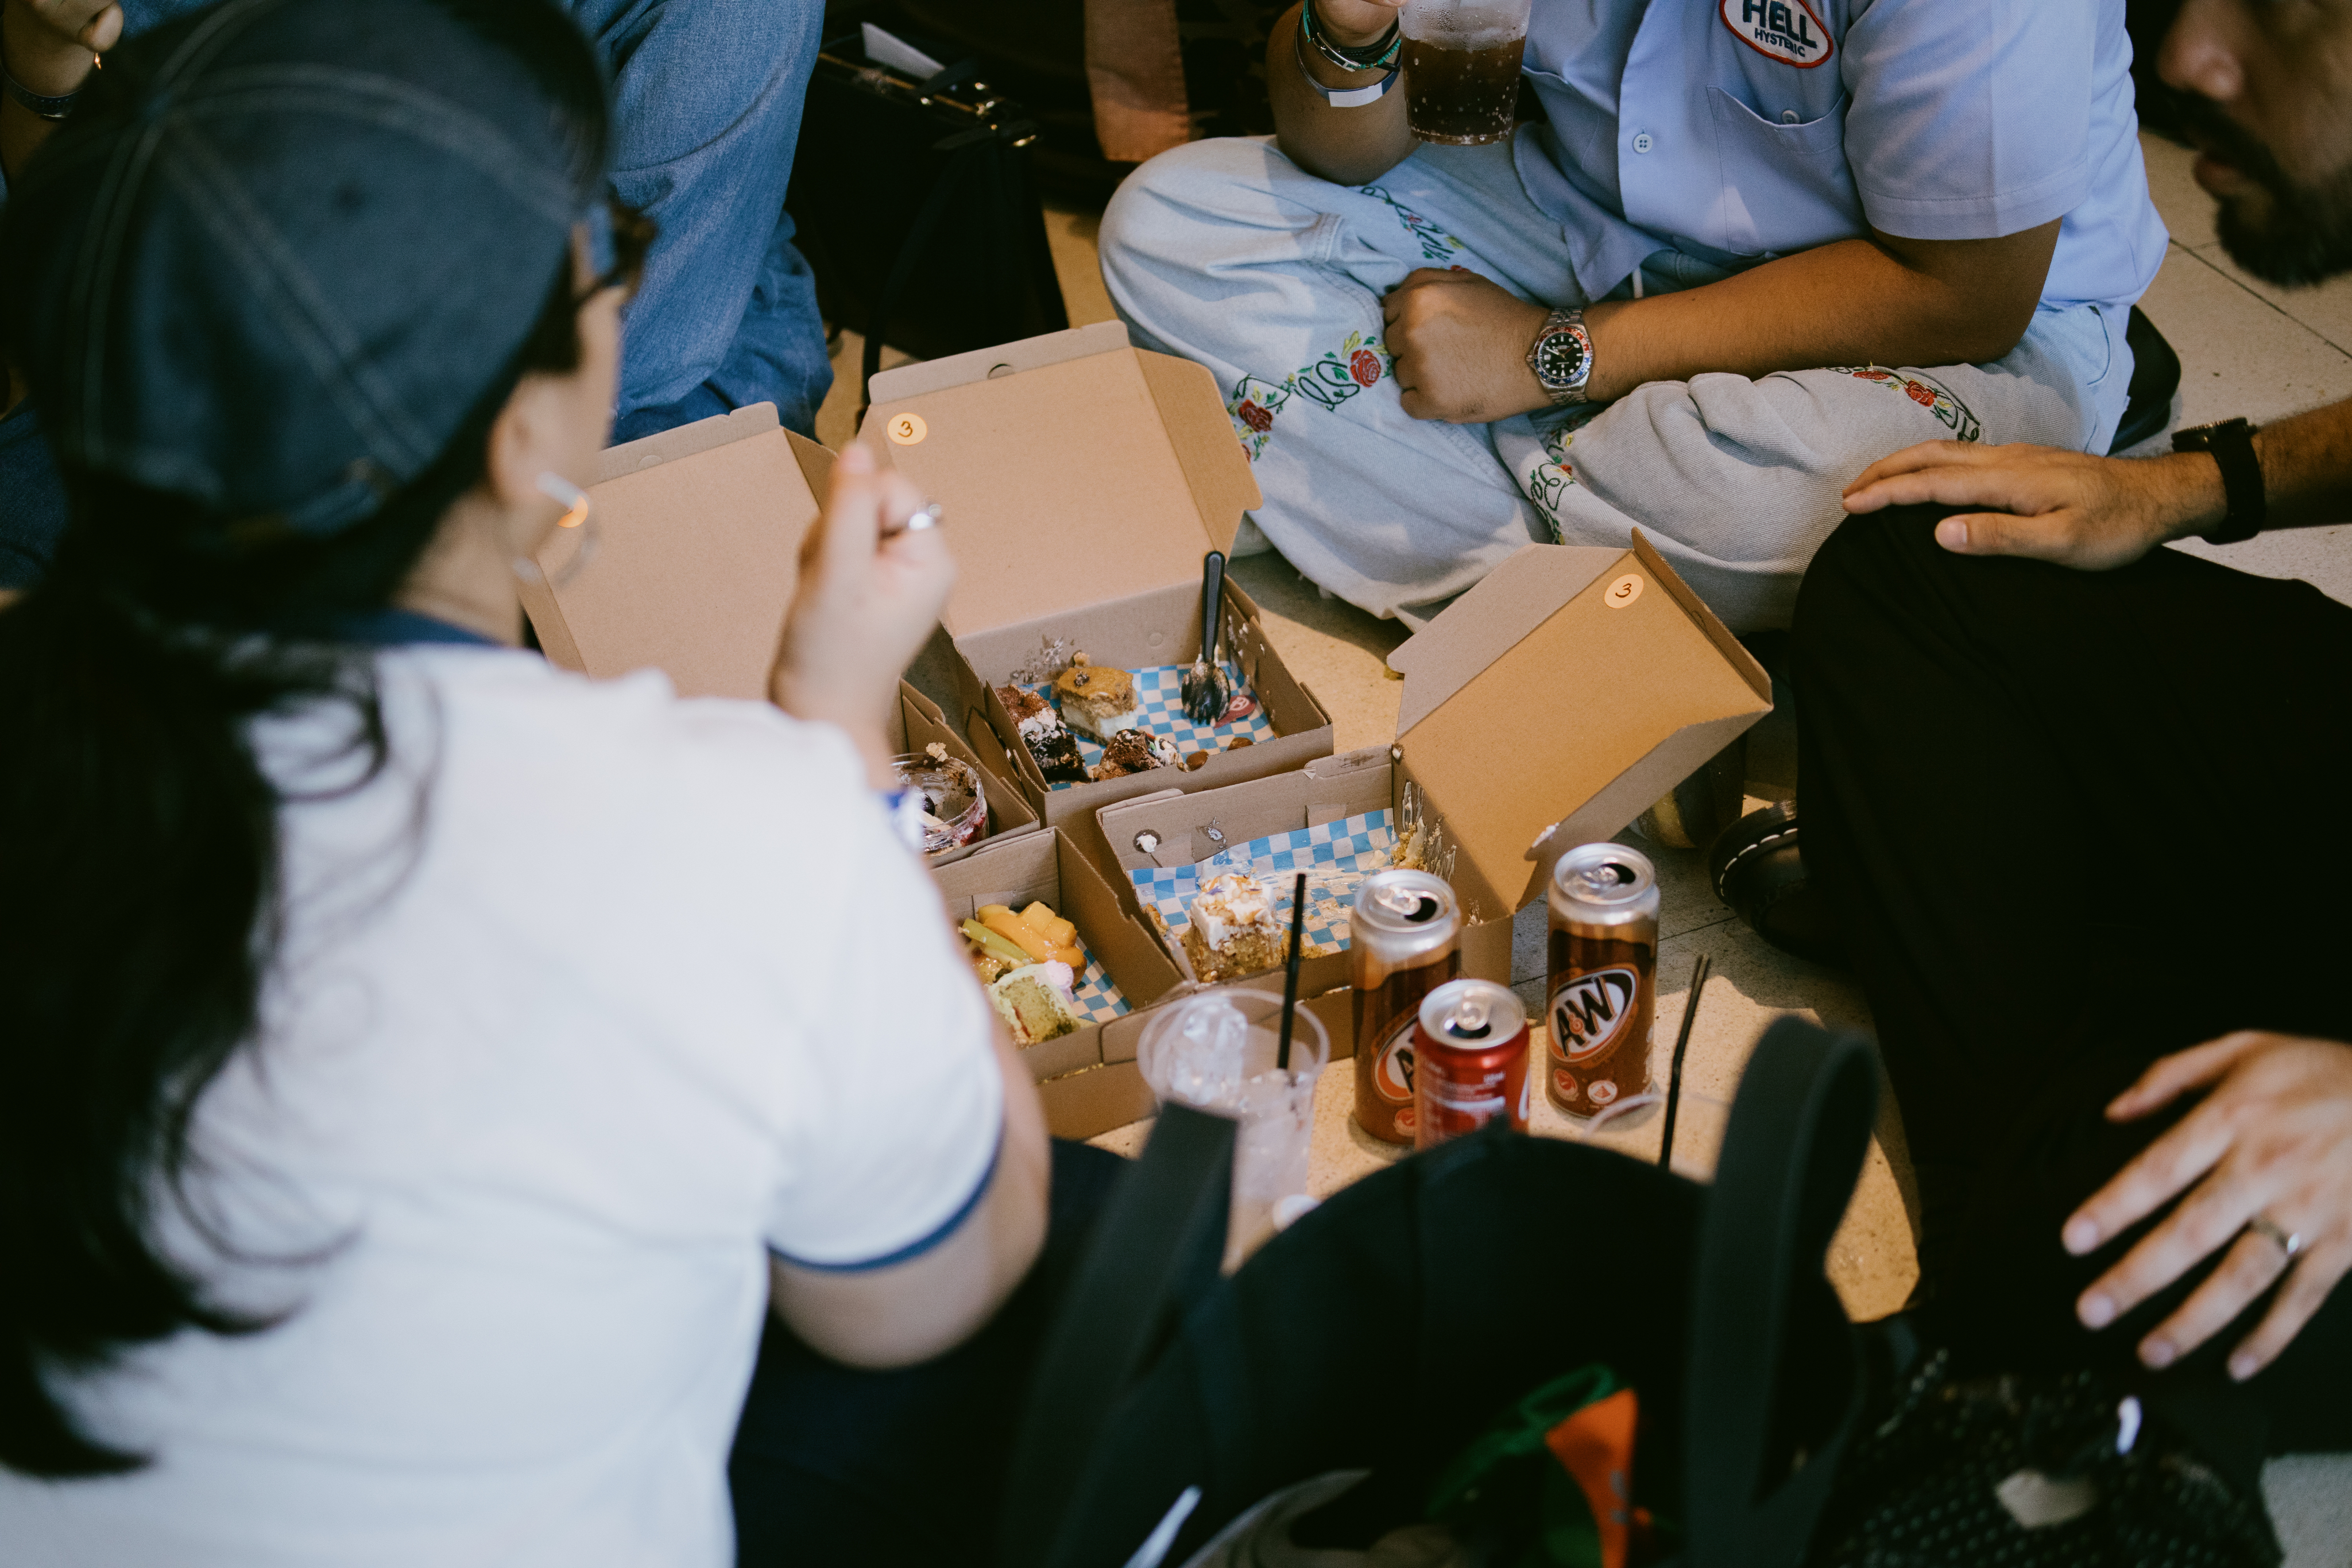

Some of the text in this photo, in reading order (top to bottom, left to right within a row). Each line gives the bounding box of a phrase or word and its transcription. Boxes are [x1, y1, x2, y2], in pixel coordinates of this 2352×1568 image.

[1742, 0, 1817, 49] HELL
[1754, 28, 1805, 57] HYSTERIC
[1580, 363, 1587, 371] 20
[898, 420, 913, 438] 3
[1615, 583, 1632, 598] 3
